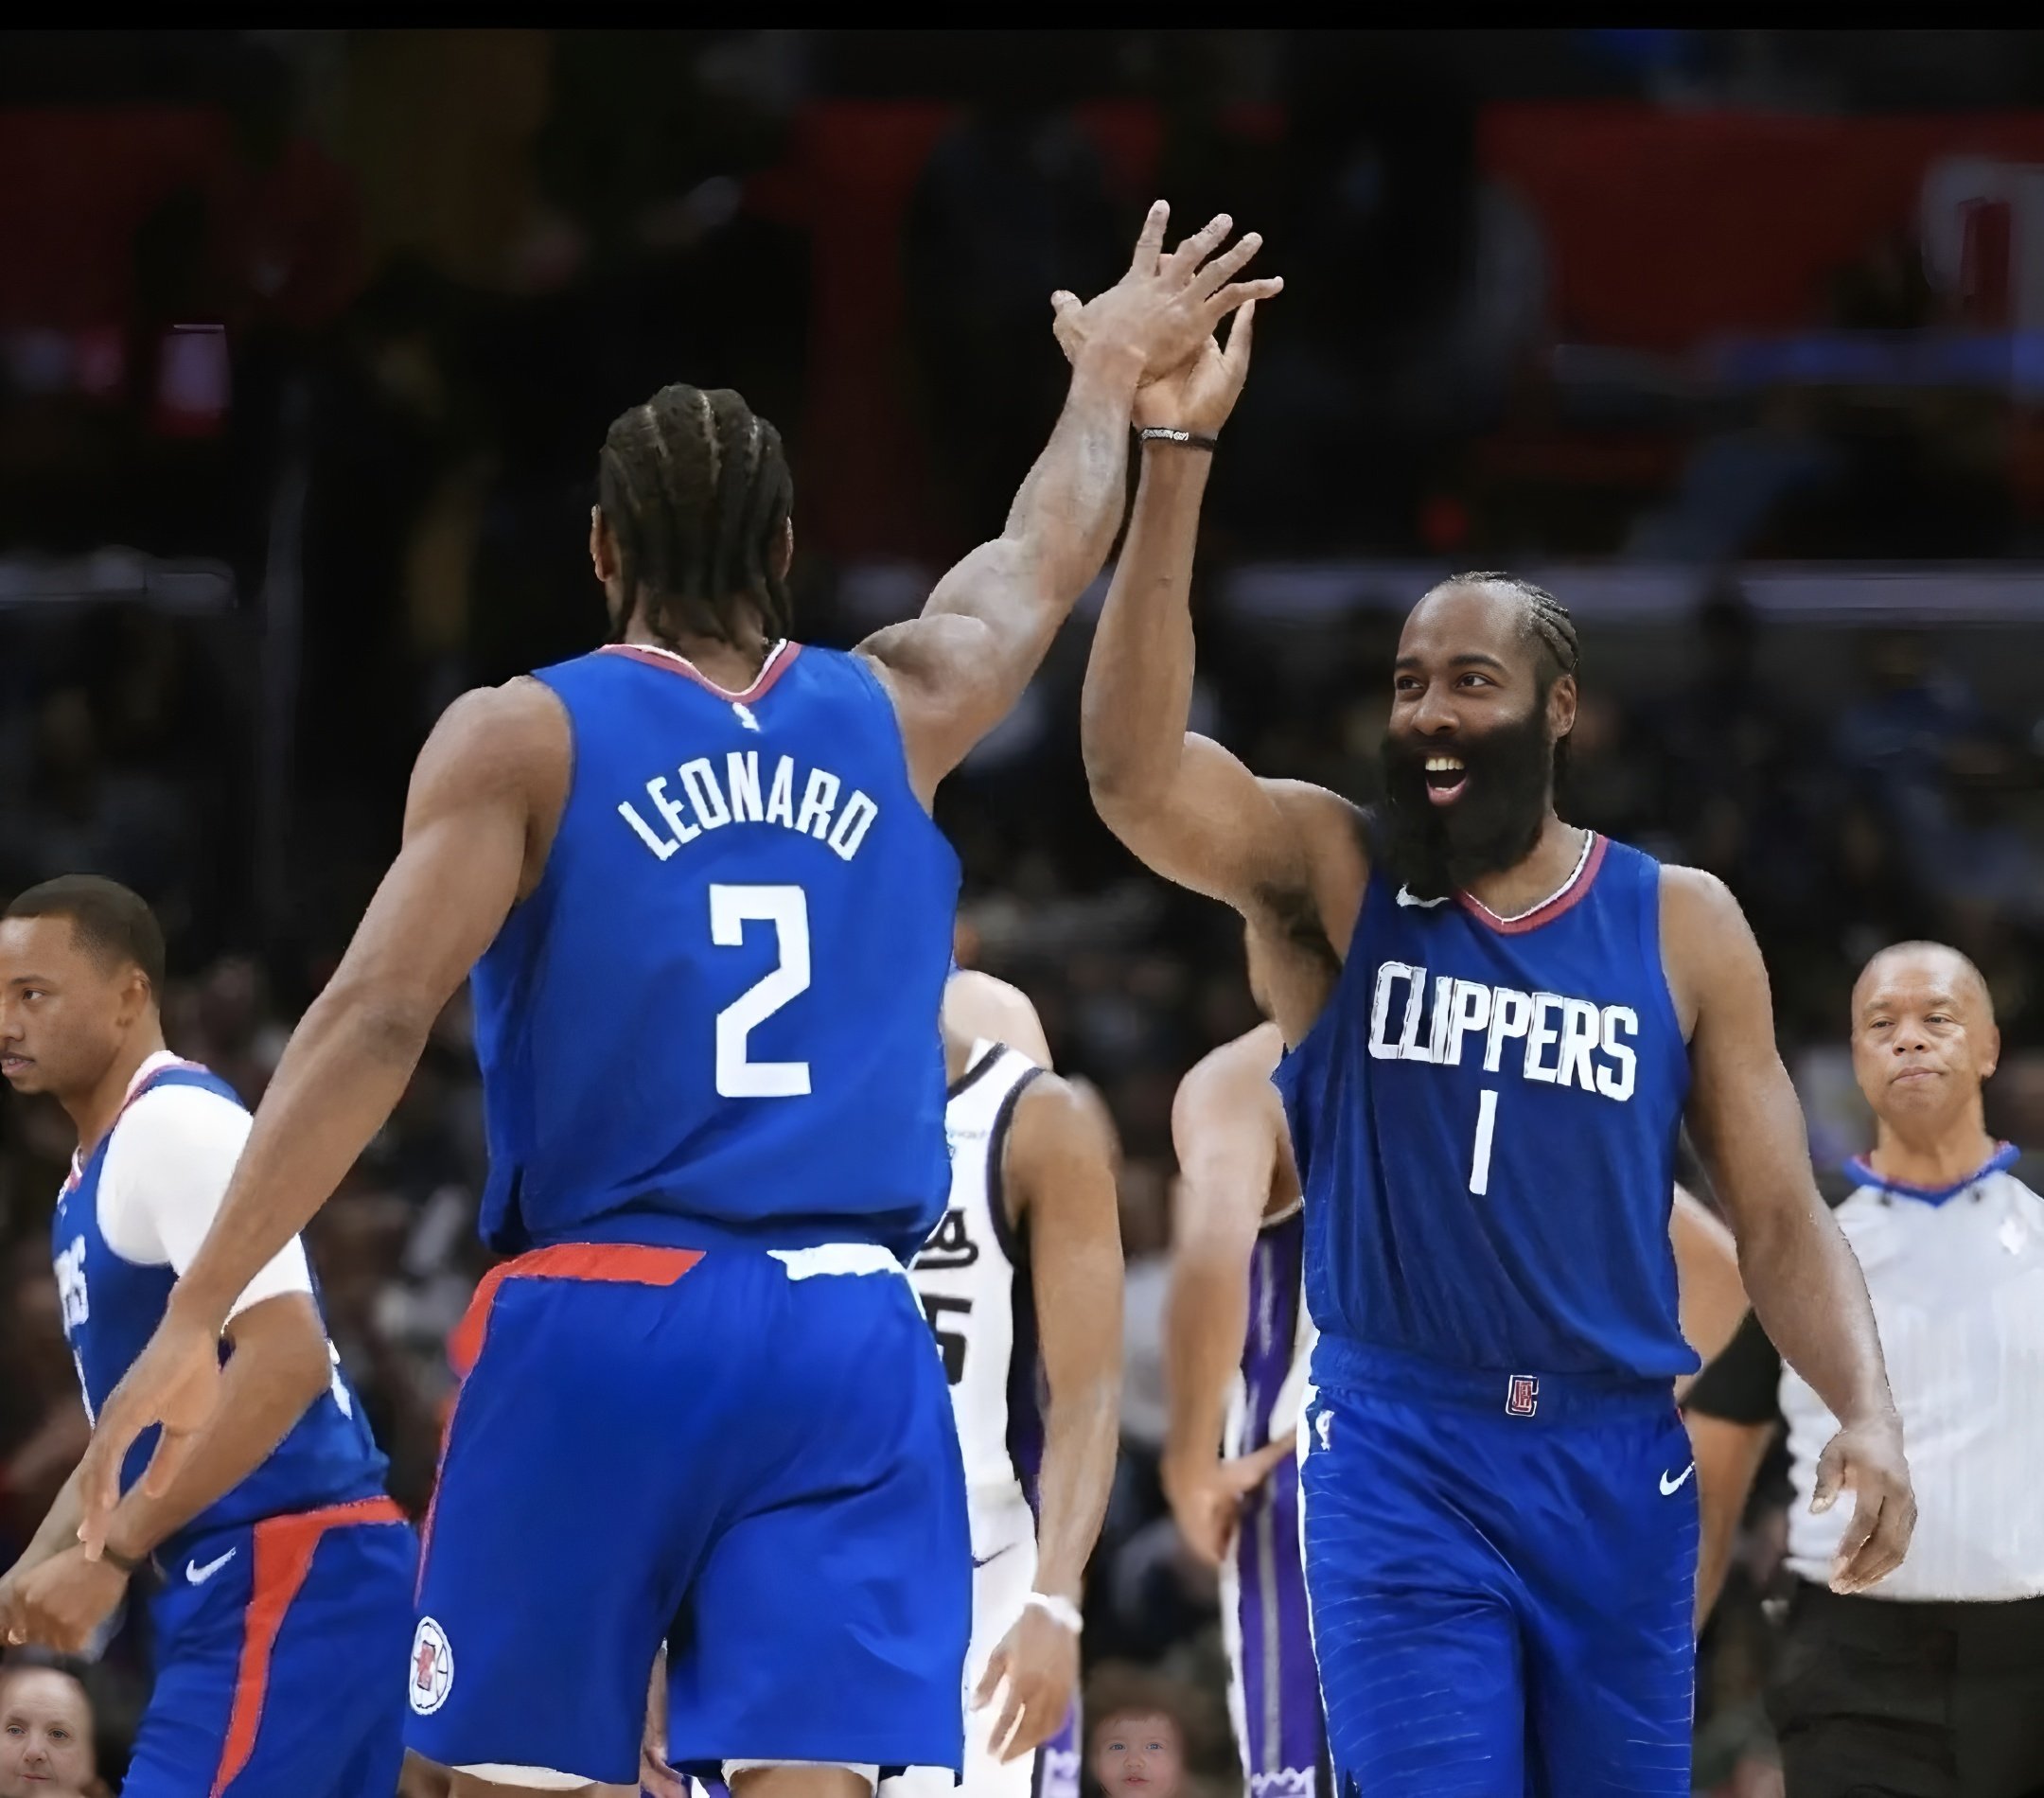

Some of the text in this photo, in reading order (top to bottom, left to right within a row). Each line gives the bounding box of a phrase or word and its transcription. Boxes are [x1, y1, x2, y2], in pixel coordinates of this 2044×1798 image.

[618, 750, 878, 861] LEONARD
[710, 883, 811, 1098] 2
[1368, 961, 1638, 1102] CLIPPERS
[1469, 1089, 1498, 1195] 1
